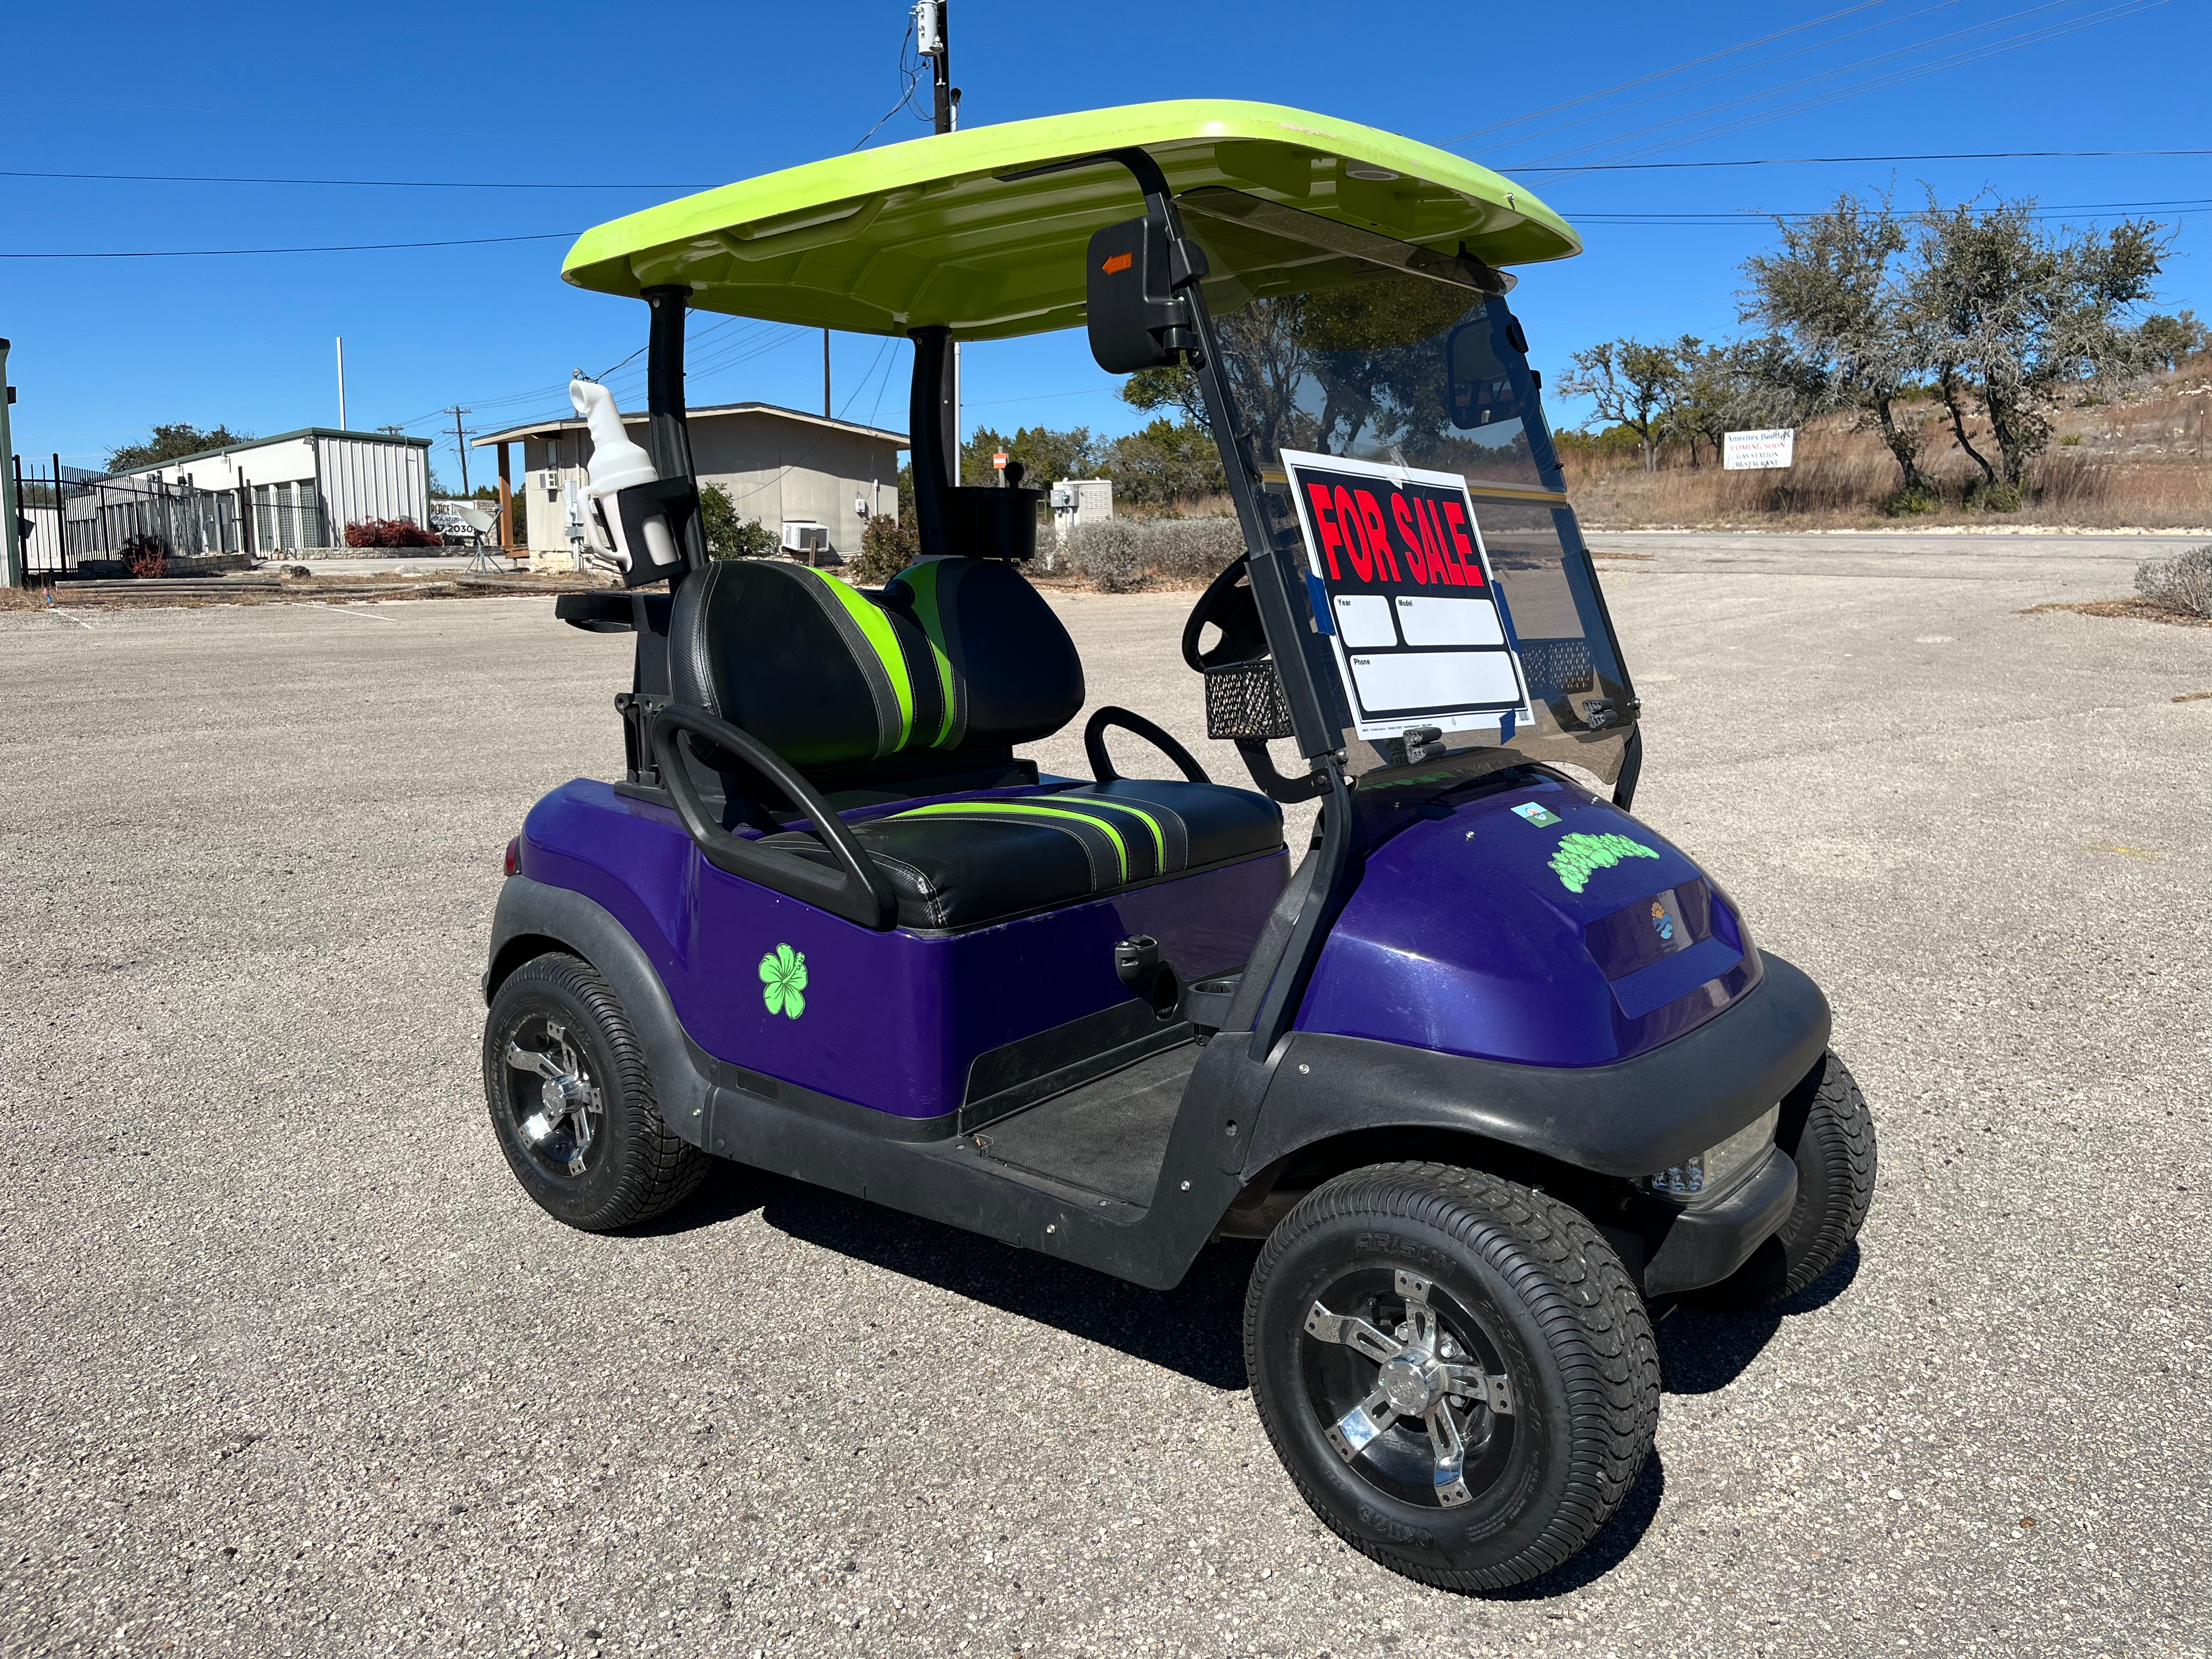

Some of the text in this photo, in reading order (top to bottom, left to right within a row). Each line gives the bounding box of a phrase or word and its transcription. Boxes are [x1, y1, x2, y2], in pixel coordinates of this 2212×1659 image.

[1728, 434, 1758, 442] Ameritex
[1730, 443, 1762, 452] COMING
[1307, 483, 1485, 586] FOR SALE
[1779, 1193, 1808, 1246] CRUZ
[1355, 1232, 1457, 1278] ARISUN
[1477, 1300, 1542, 1436] 205/65-10
[1359, 1504, 1435, 1551] CRUZE
